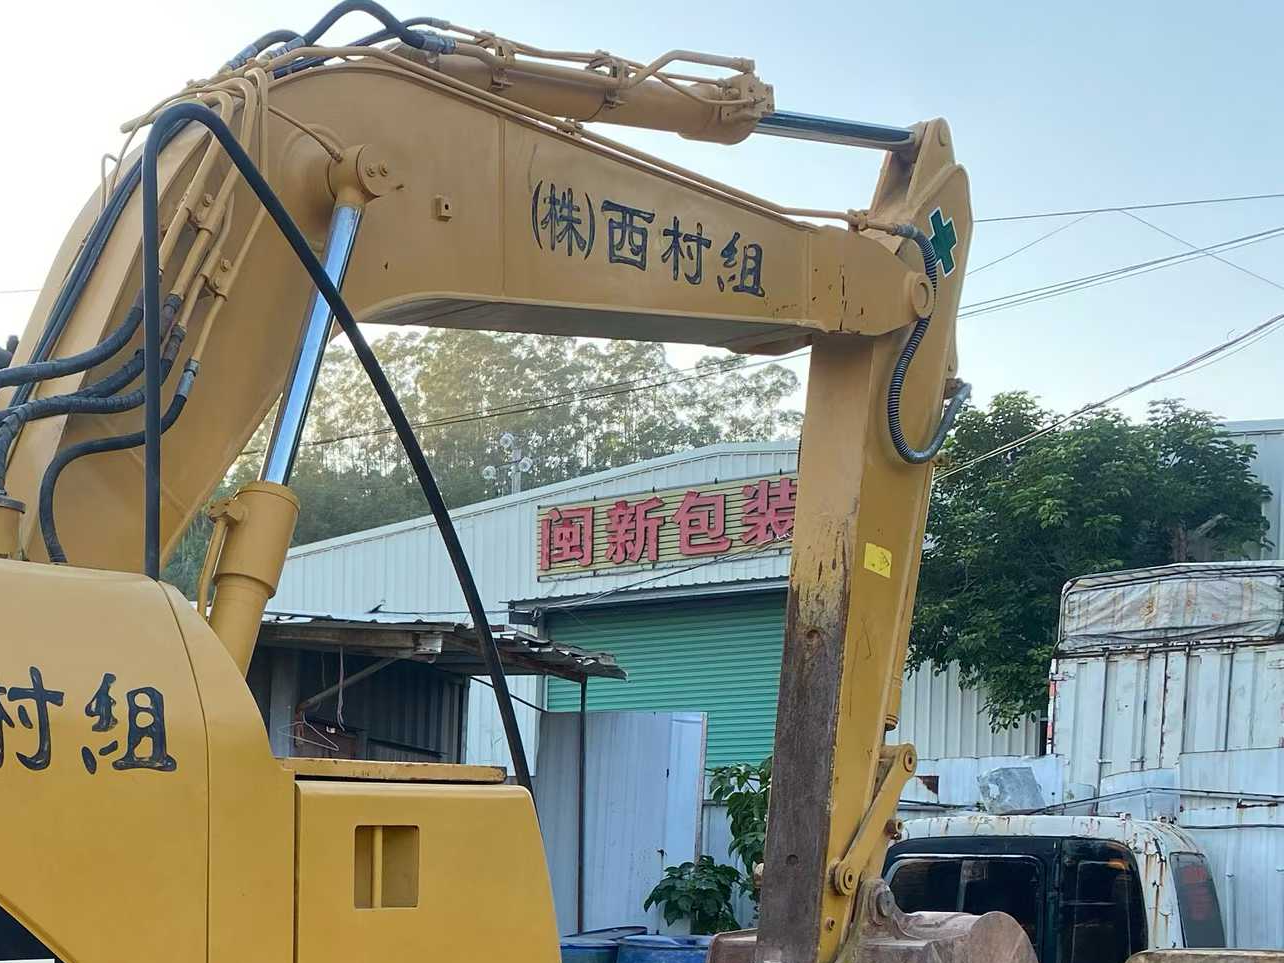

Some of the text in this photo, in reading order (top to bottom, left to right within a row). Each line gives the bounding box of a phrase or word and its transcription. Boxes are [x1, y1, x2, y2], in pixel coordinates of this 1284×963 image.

[532, 180, 765, 297] (株)西村組
[540, 478, 798, 571] 闽新包装
